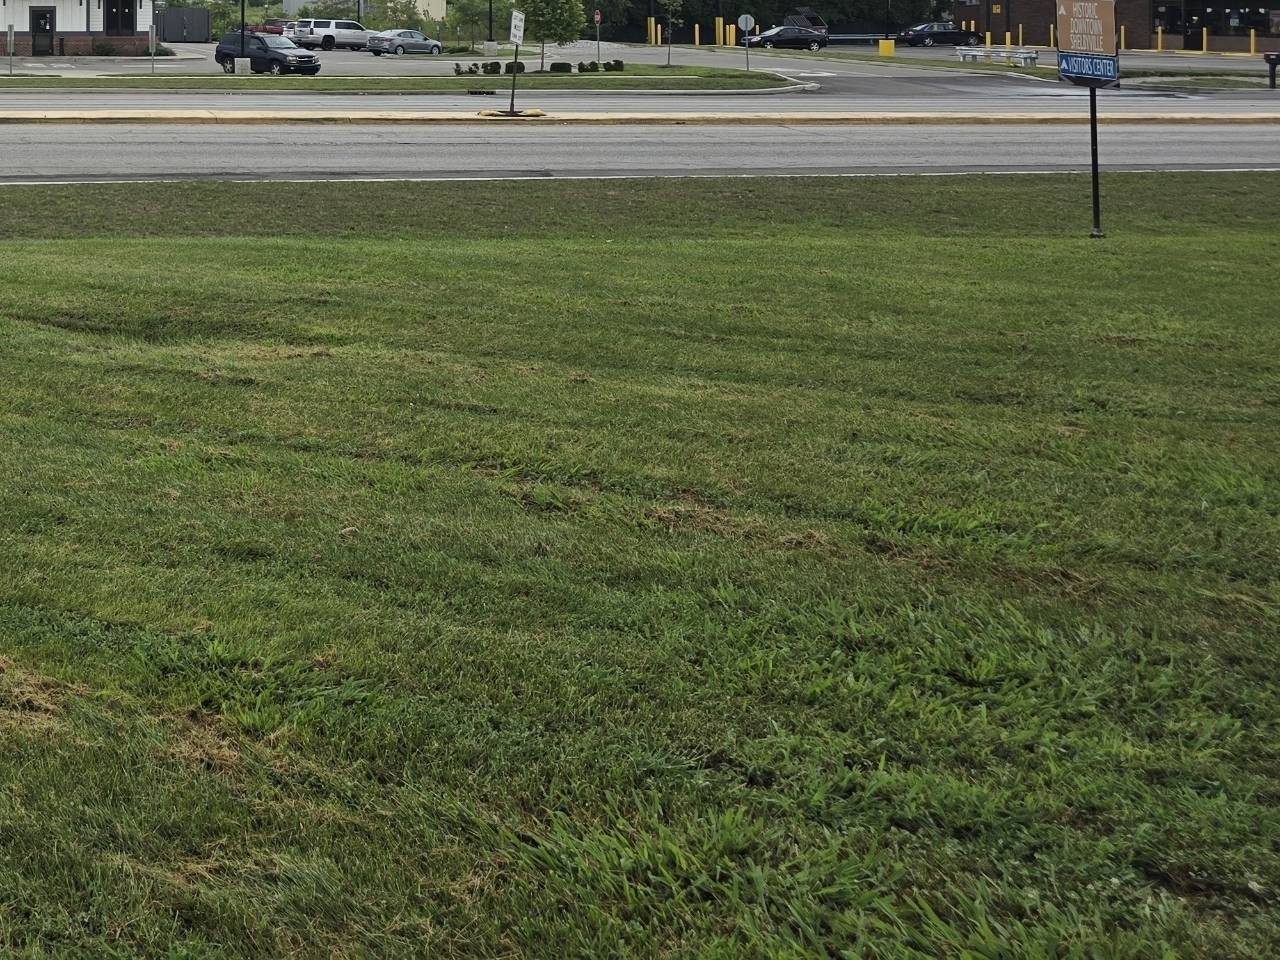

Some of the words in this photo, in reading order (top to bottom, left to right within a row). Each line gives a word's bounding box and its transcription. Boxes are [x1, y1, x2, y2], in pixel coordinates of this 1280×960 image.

[1072, 2, 1099, 19] HISTORIC
[1070, 18, 1103, 36] DOWNTOWN
[1070, 34, 1104, 51] SHELBYVILLE
[1067, 56, 1093, 74] VISITORS
[1093, 58, 1115, 76] CENTER
